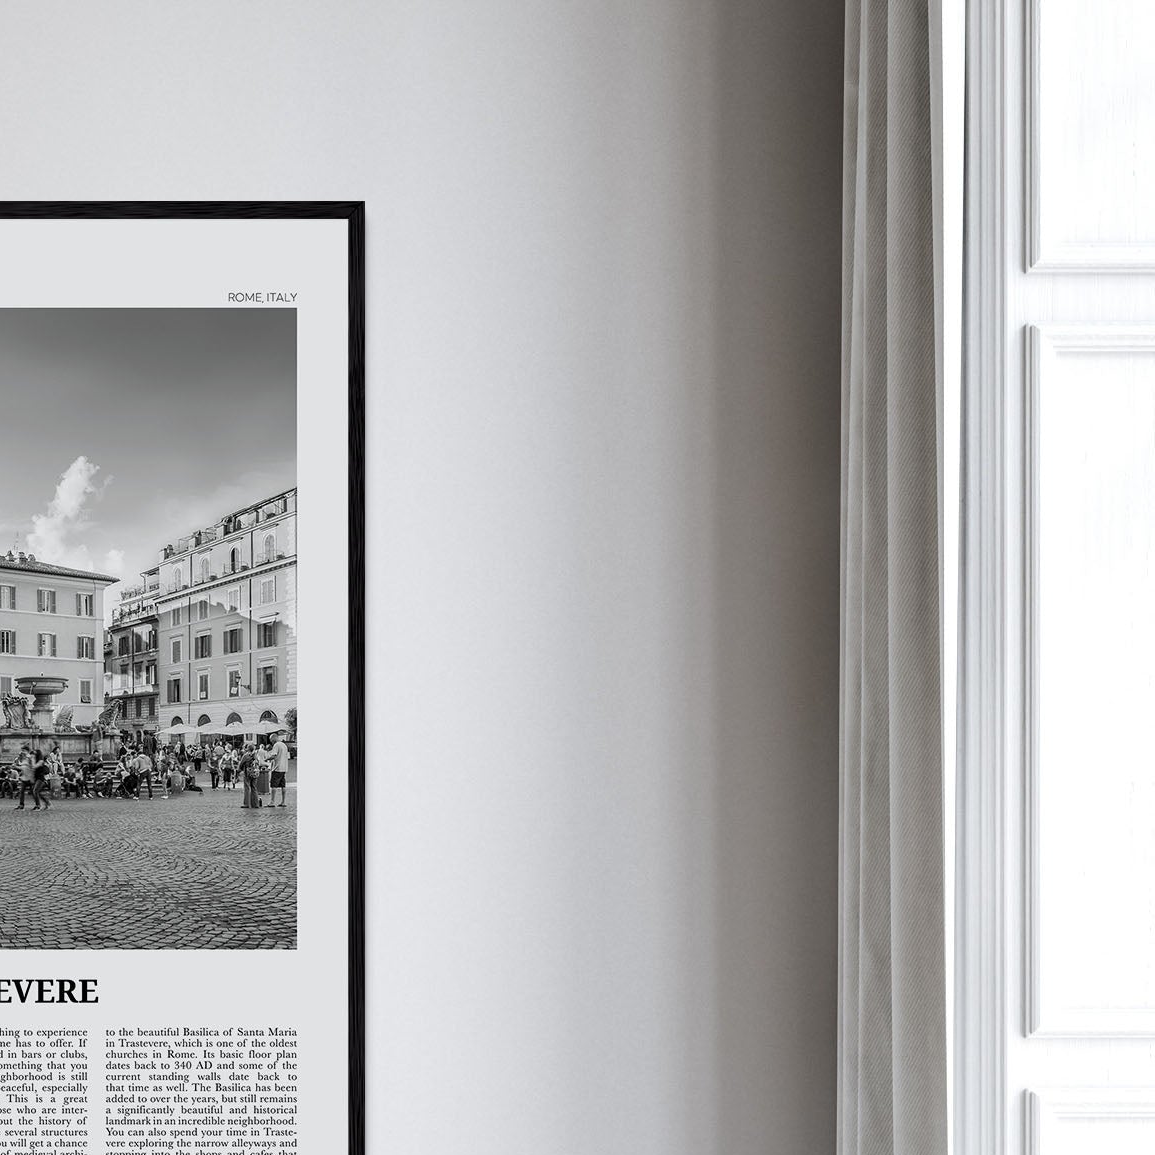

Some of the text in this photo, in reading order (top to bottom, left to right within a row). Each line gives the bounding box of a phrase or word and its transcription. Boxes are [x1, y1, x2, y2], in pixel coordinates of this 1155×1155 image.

[228, 292, 298, 304] ROME, ITALY
[37, 1028, 87, 1039] experience
[119, 1028, 133, 1036] the
[138, 1028, 179, 1036] beautiful
[184, 1028, 219, 1036] Basilica
[223, 1028, 233, 1036] of
[237, 1028, 264, 1036] Santa
[268, 1028, 297, 1036] Maria
[106, 1050, 297, 1061] churches in Rome. Its basic floor plan
[47, 1061, 66, 1069] that
[71, 1063, 87, 1072] you
[59, 1072, 65, 1080] is
[71, 1072, 87, 1080] still
[149, 1072, 189, 1083] standing
[198, 1072, 221, 1080] walls
[229, 1072, 249, 1080] date
[258, 1072, 280, 1080] back
[42, 1083, 88, 1094] especially
[17, 1105, 36, 1113] who
[62, 1105, 87, 1113] inter-
[117, 1105, 175, 1116] significantly
[181, 1105, 223, 1113] beautiful
[229, 1105, 247, 1113] and
[254, 1105, 297, 1113] historical
[106, 1116, 151, 1125] landmark
[153, 1116, 162, 1125] in
[178, 1116, 225, 1125] incredible
[228, 1116, 297, 1127] neighborhood.
[5, 1127, 37, 1136] several
[41, 1128, 88, 1136] structures
[129, 1138, 174, 1149] exploring
[177, 1138, 191, 1147] the
[232, 1138, 276, 1149] alleyways
[279, 1138, 297, 1147] and
